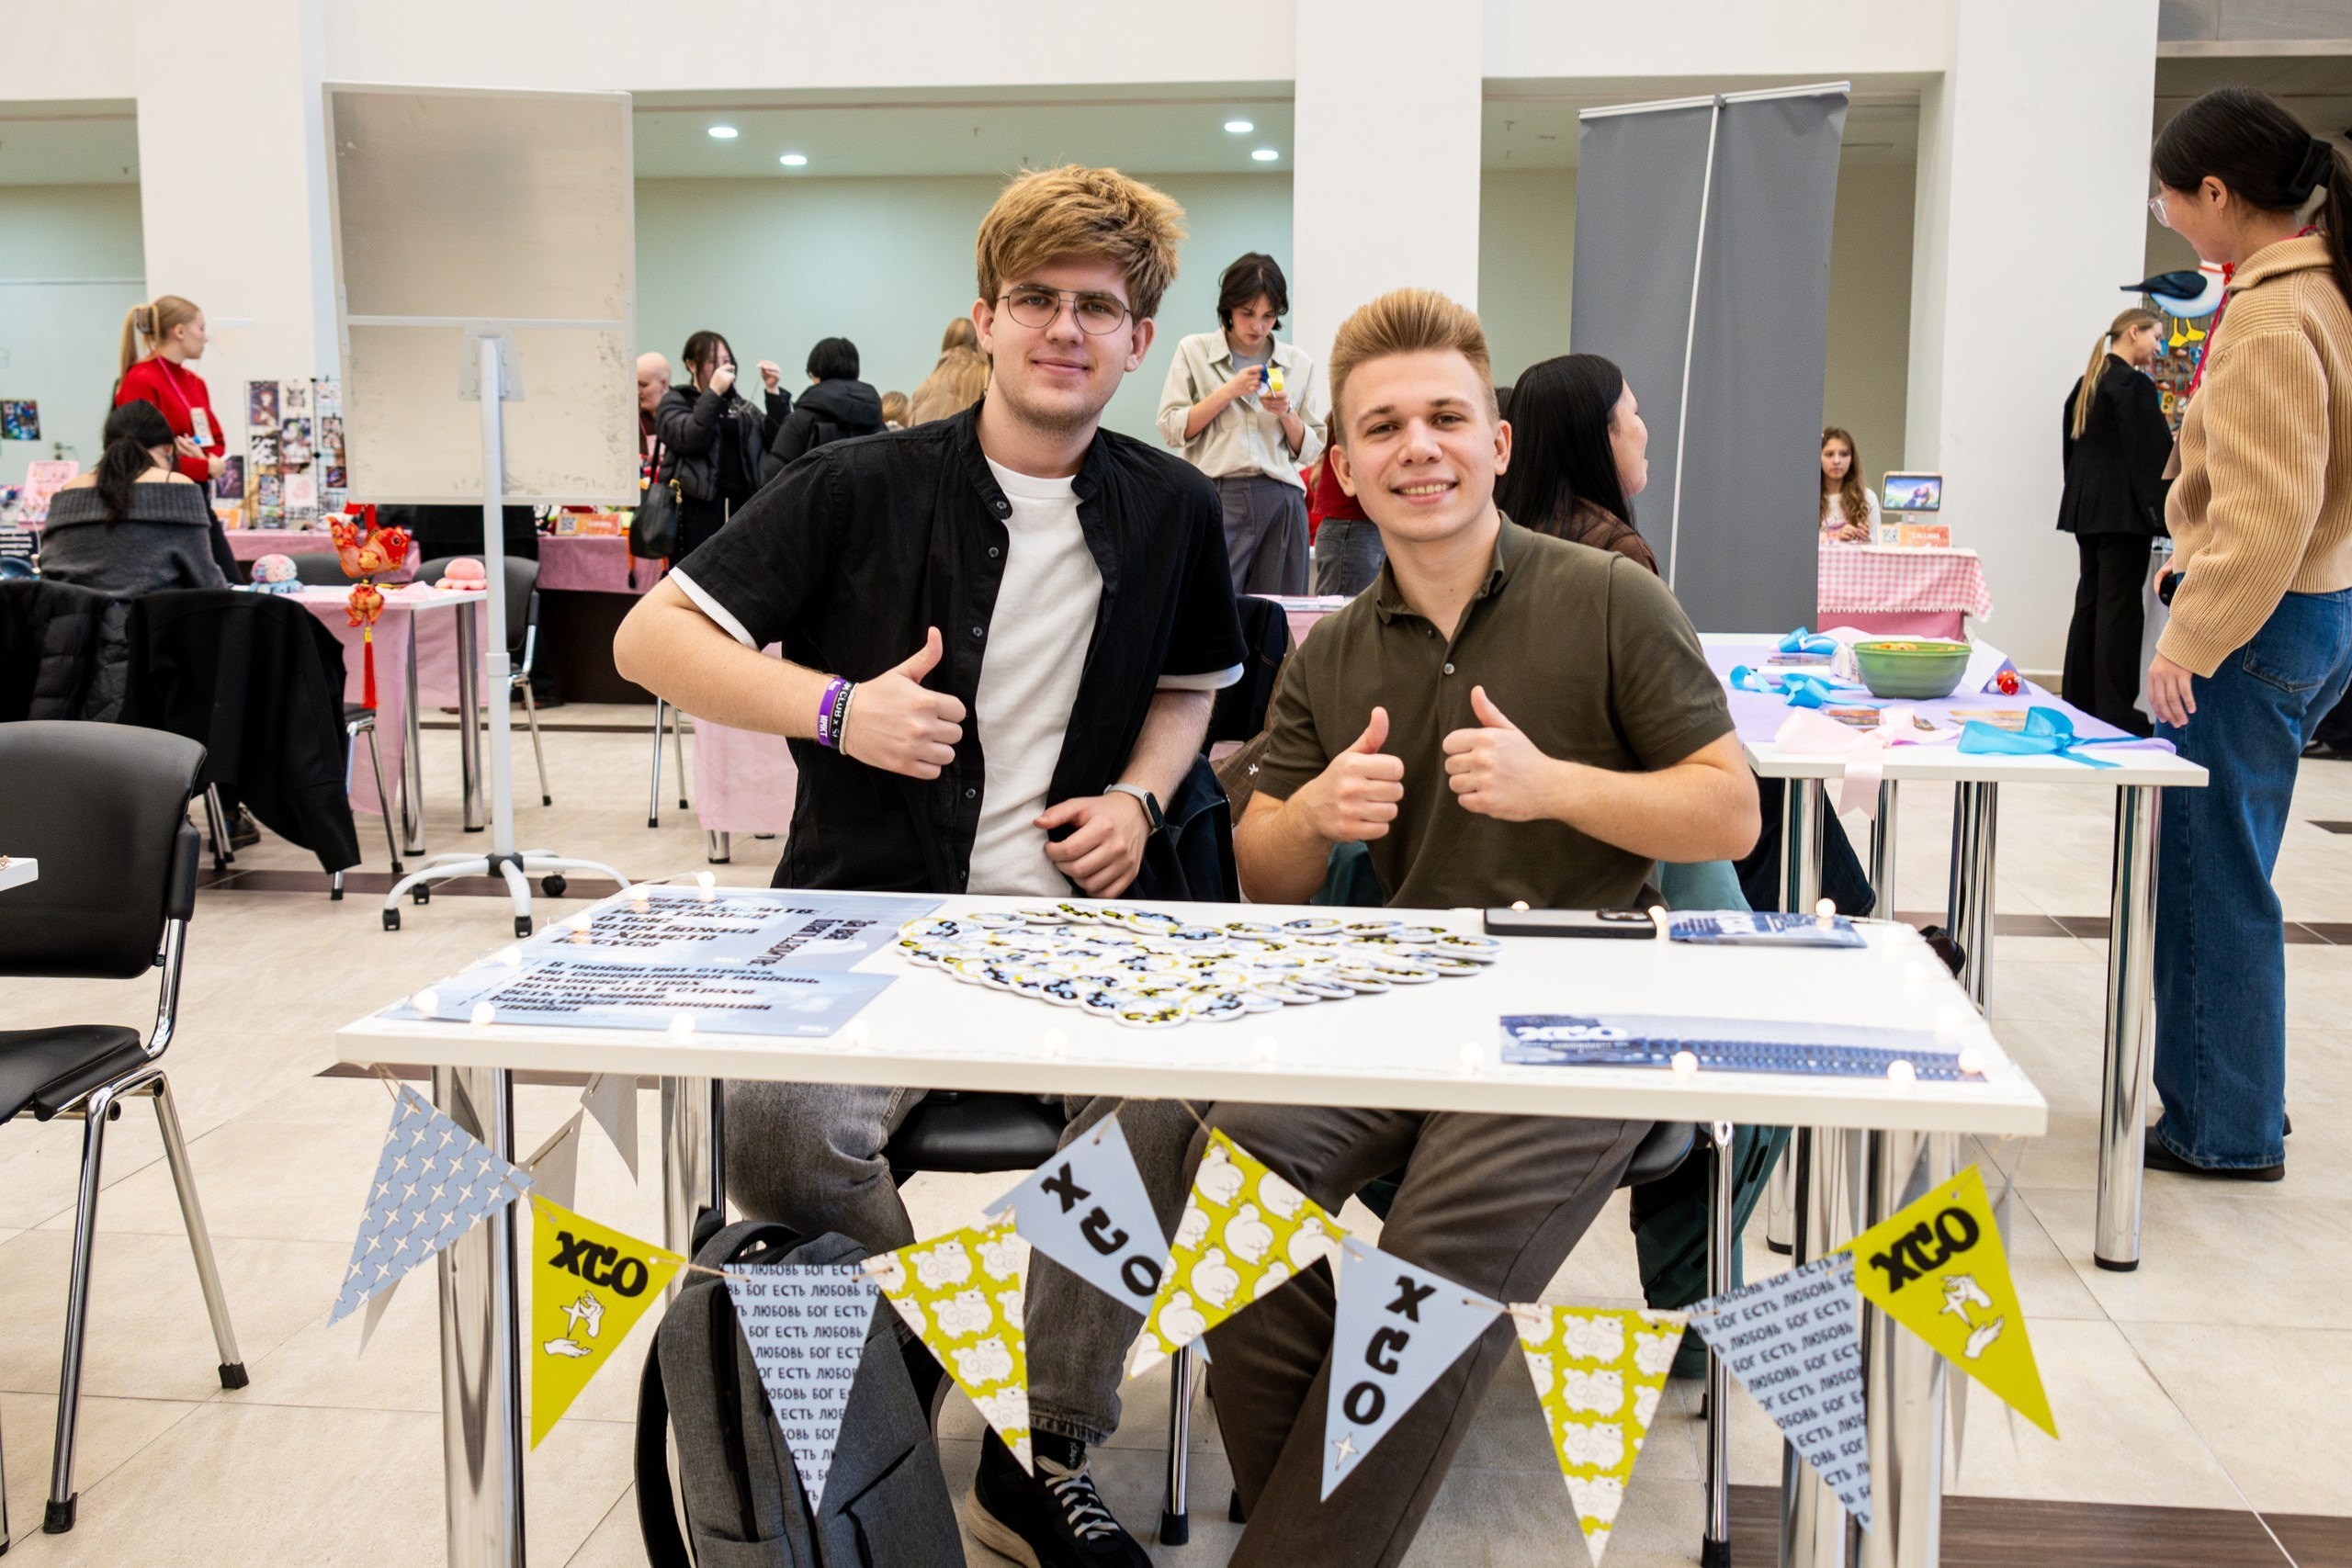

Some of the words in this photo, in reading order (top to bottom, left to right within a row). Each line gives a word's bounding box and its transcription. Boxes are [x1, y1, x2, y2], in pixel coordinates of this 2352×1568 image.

[750, 1264, 798, 1276] ЛЮБОВЬ
[805, 1264, 825, 1276] БОГ
[746, 1284, 767, 1296] БОГ
[773, 1284, 806, 1297] ЕСТЬ
[810, 1284, 860, 1297] ЛЮБОВЬ
[752, 1305, 801, 1317] ЛЮБОВЬ
[807, 1305, 829, 1317] БОГ
[834, 1305, 867, 1317] ЕСТЬ
[1714, 1312, 1738, 1332] БОГ
[1742, 1301, 1779, 1322] ЕСТЬ
[1783, 1280, 1836, 1308] ЛЮБОВЬ
[1730, 1323, 1782, 1350] ЛЮБОВЬ
[1785, 1311, 1810, 1332] БОГ
[1814, 1298, 1852, 1320] ЕСТЬ
[749, 1326, 770, 1337] БОГ
[775, 1326, 808, 1337] ЕСТЬ
[813, 1326, 864, 1338] ЛЮБОВЬ
[755, 1347, 804, 1359] ЛЮБОВЬ
[809, 1347, 831, 1359] БОГ
[1732, 1354, 1756, 1373] БОГ
[1760, 1342, 1798, 1363] ЕСТЬ
[1802, 1321, 1854, 1350] ЛЮБОВЬ
[778, 1367, 811, 1379] ЕСТЬ
[1747, 1365, 1801, 1393] ЛЮБОВЬ
[1804, 1352, 1827, 1372] БОГ
[812, 1388, 833, 1400] БОГ
[1779, 1383, 1815, 1405] ЕСТЬ
[1822, 1394, 1847, 1415] БОГ
[781, 1408, 814, 1420] ЕСТЬ
[816, 1428, 836, 1440] БОГ
[1796, 1426, 1835, 1448] ЕСТЬ
[1840, 1438, 1863, 1457] БОГ
